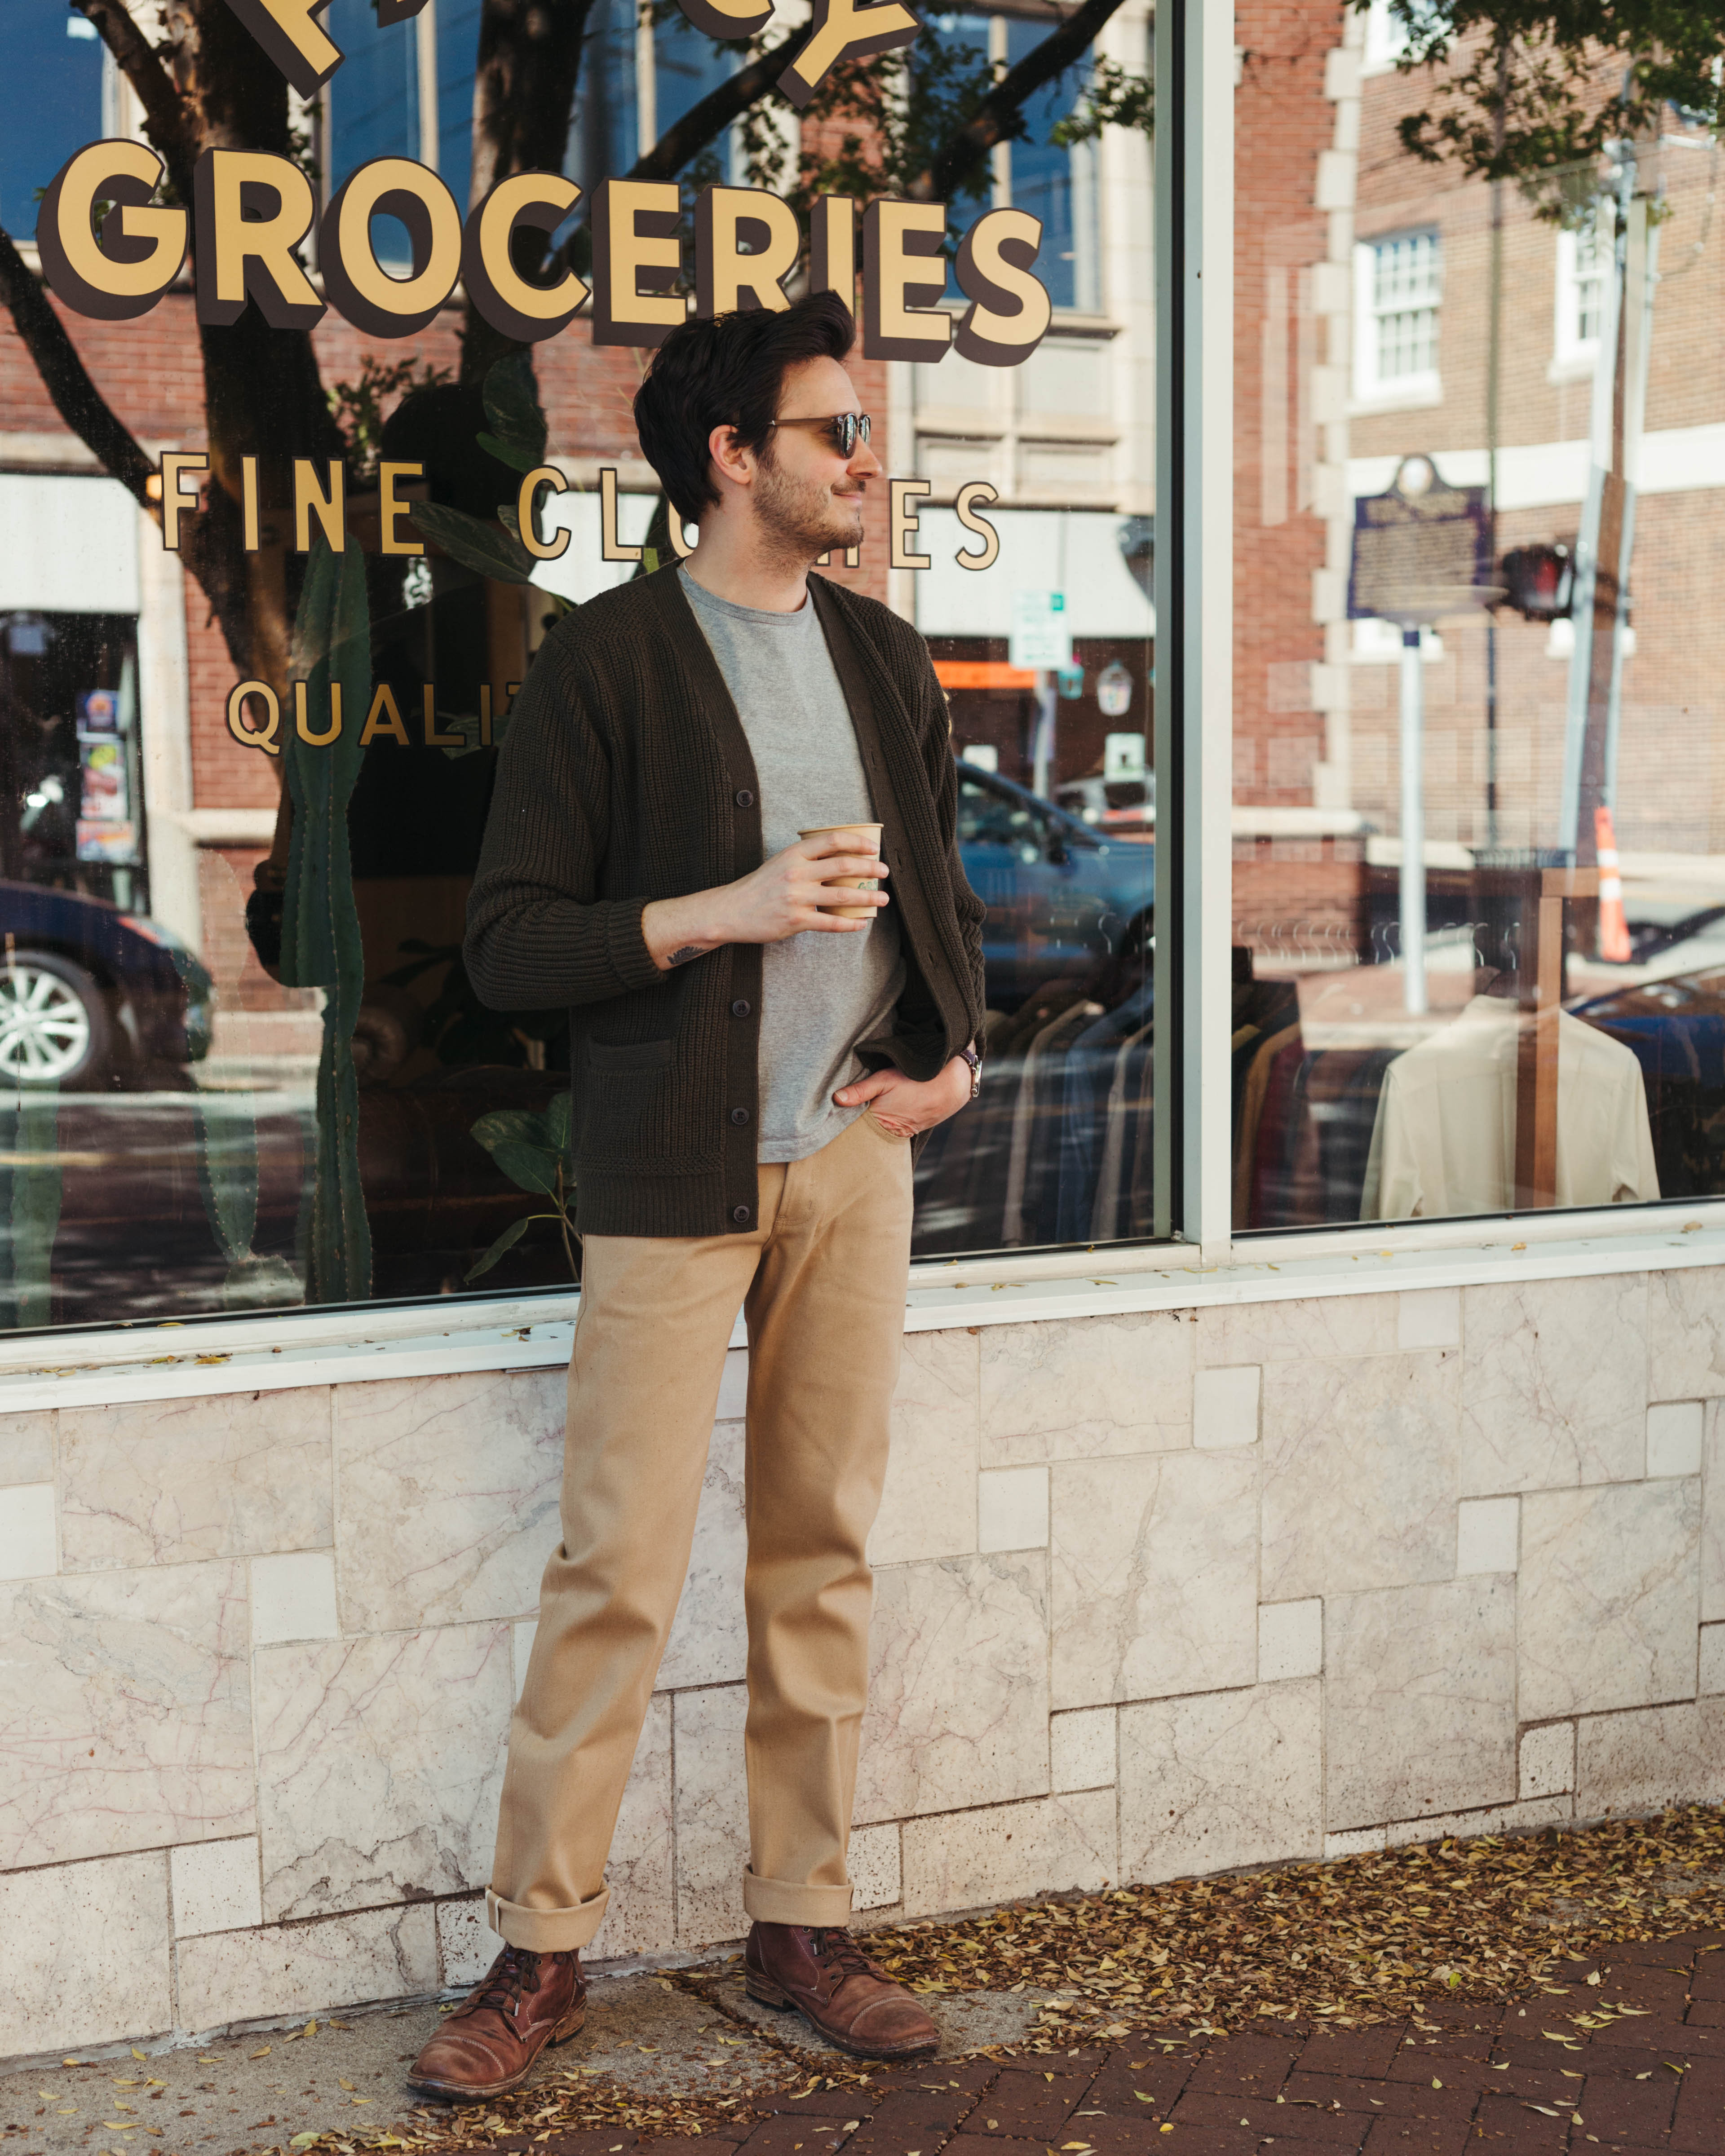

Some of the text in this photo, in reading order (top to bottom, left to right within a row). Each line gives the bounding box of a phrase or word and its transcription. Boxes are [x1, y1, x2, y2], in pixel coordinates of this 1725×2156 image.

[37, 137, 1052, 367] GROCERIES
[160, 451, 1000, 571] FINE CLES
[226, 679, 522, 756] QUALI
